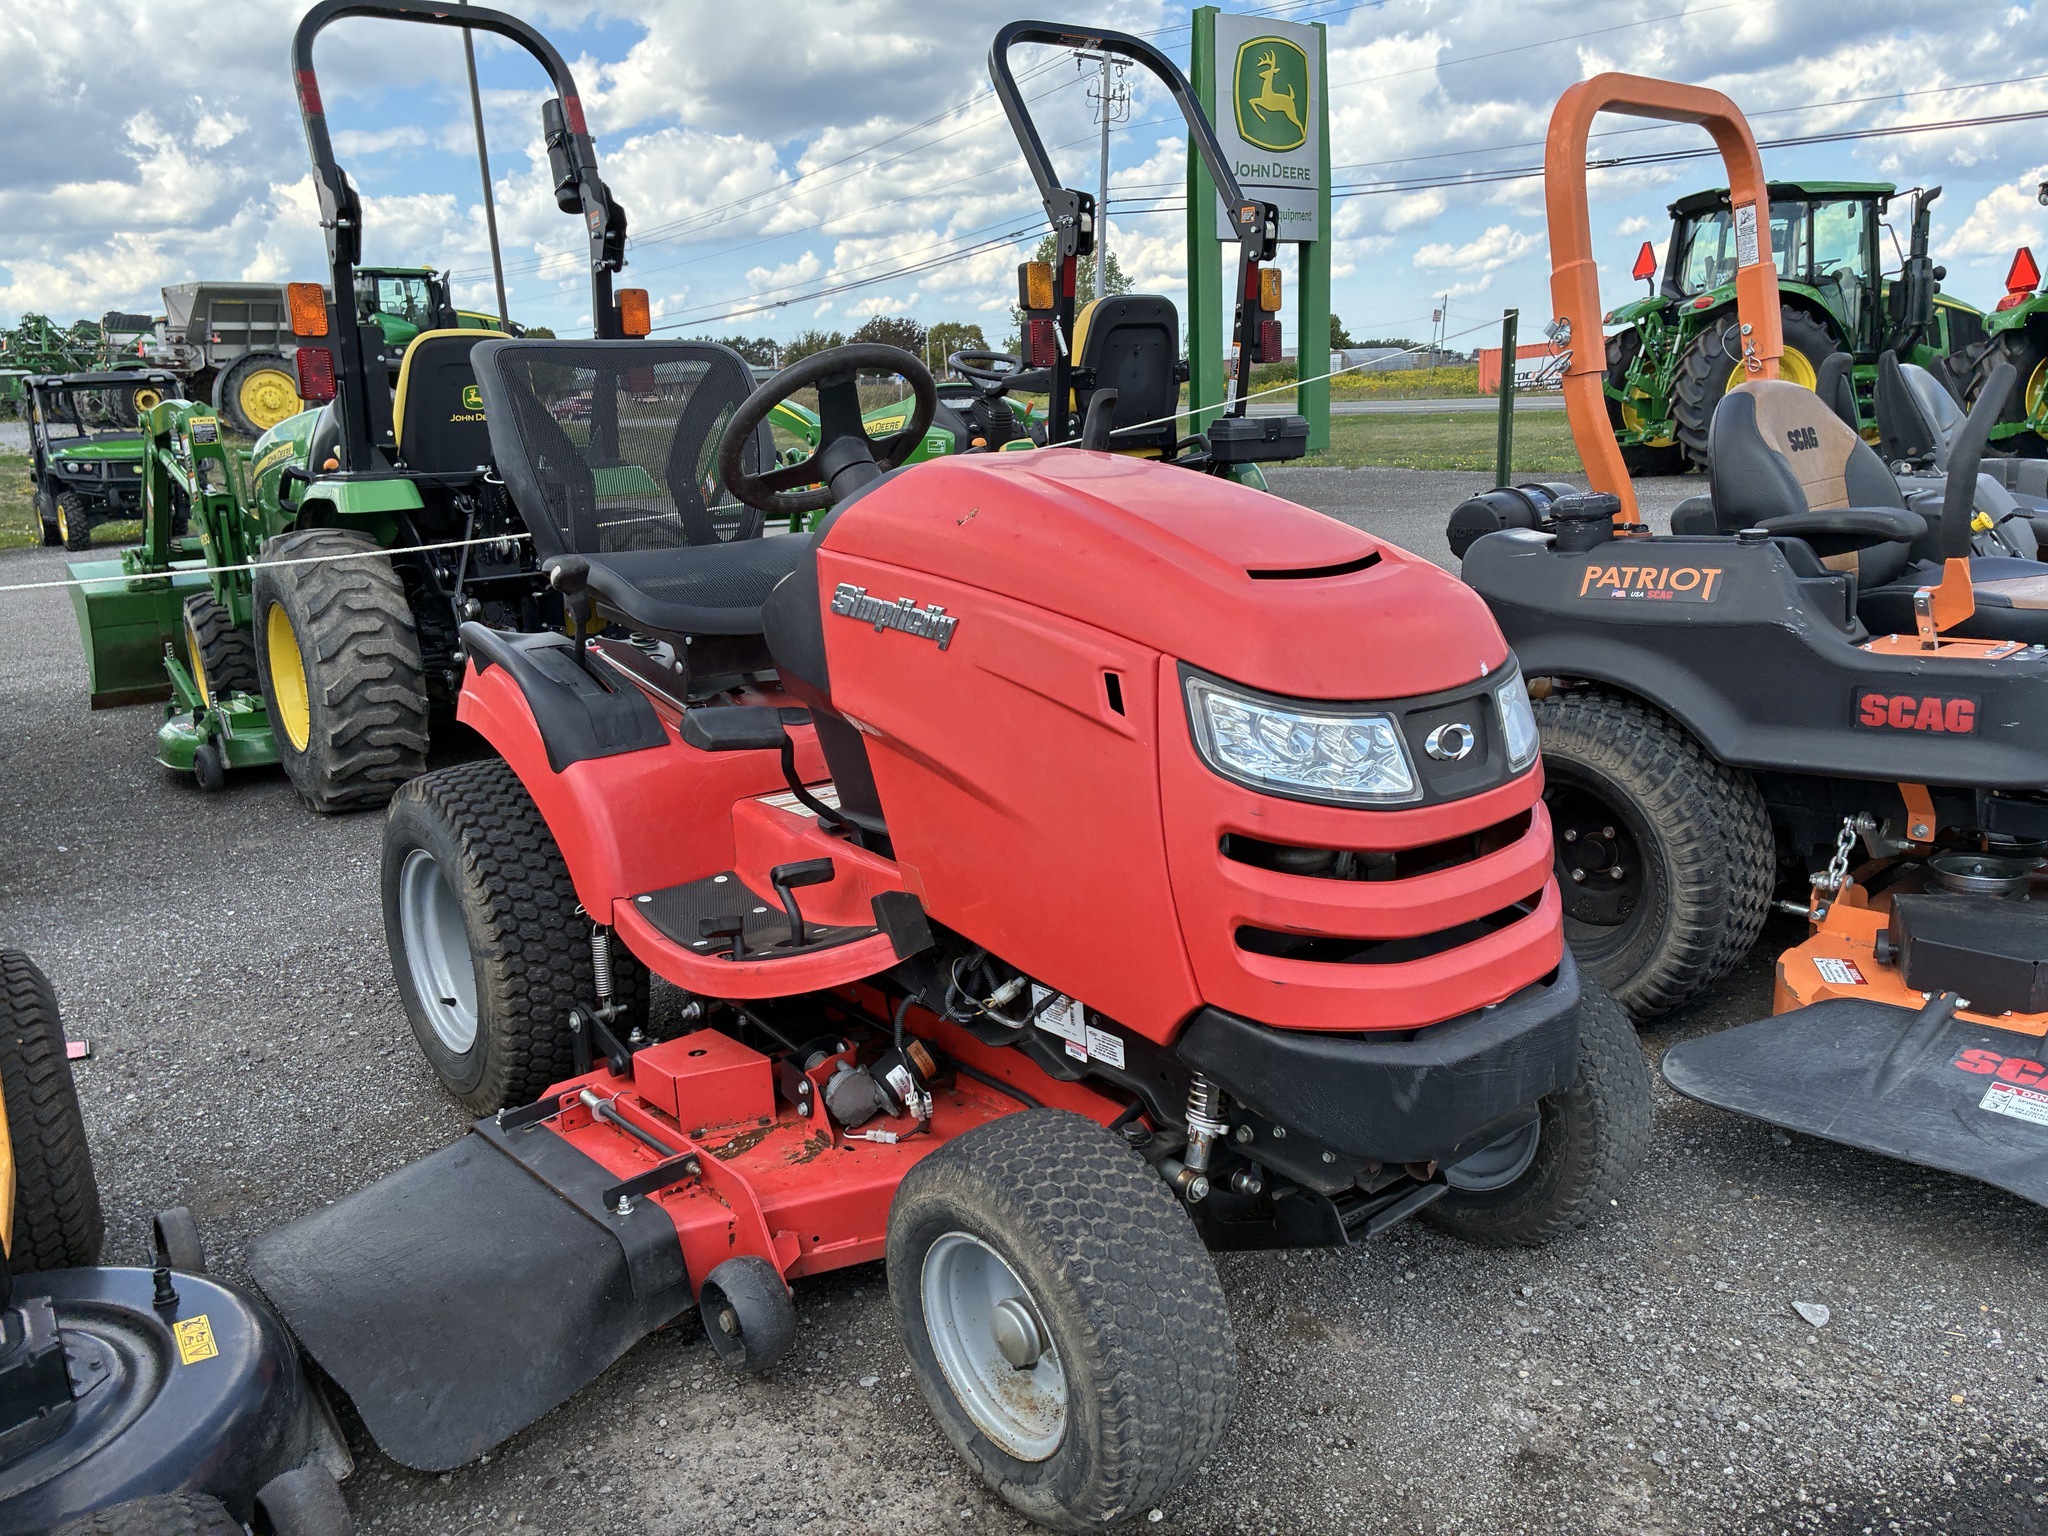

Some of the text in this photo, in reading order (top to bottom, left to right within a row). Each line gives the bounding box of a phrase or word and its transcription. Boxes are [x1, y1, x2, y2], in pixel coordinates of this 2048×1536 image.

[1234, 161, 1311, 180] JOHN DEERE
[1278, 208, 1313, 222] quipment
[449, 413, 487, 422] JOHN DE
[875, 421, 901, 432] DEERE
[1787, 427, 1819, 452] SCAG
[1579, 566, 1722, 601] PATRIOT
[1647, 590, 1674, 600] SCAG
[830, 582, 959, 651] Simplicity
[1860, 693, 1975, 733] SCAG
[1954, 1048, 2048, 1091] SC
[2021, 1091, 2048, 1103] DAN
